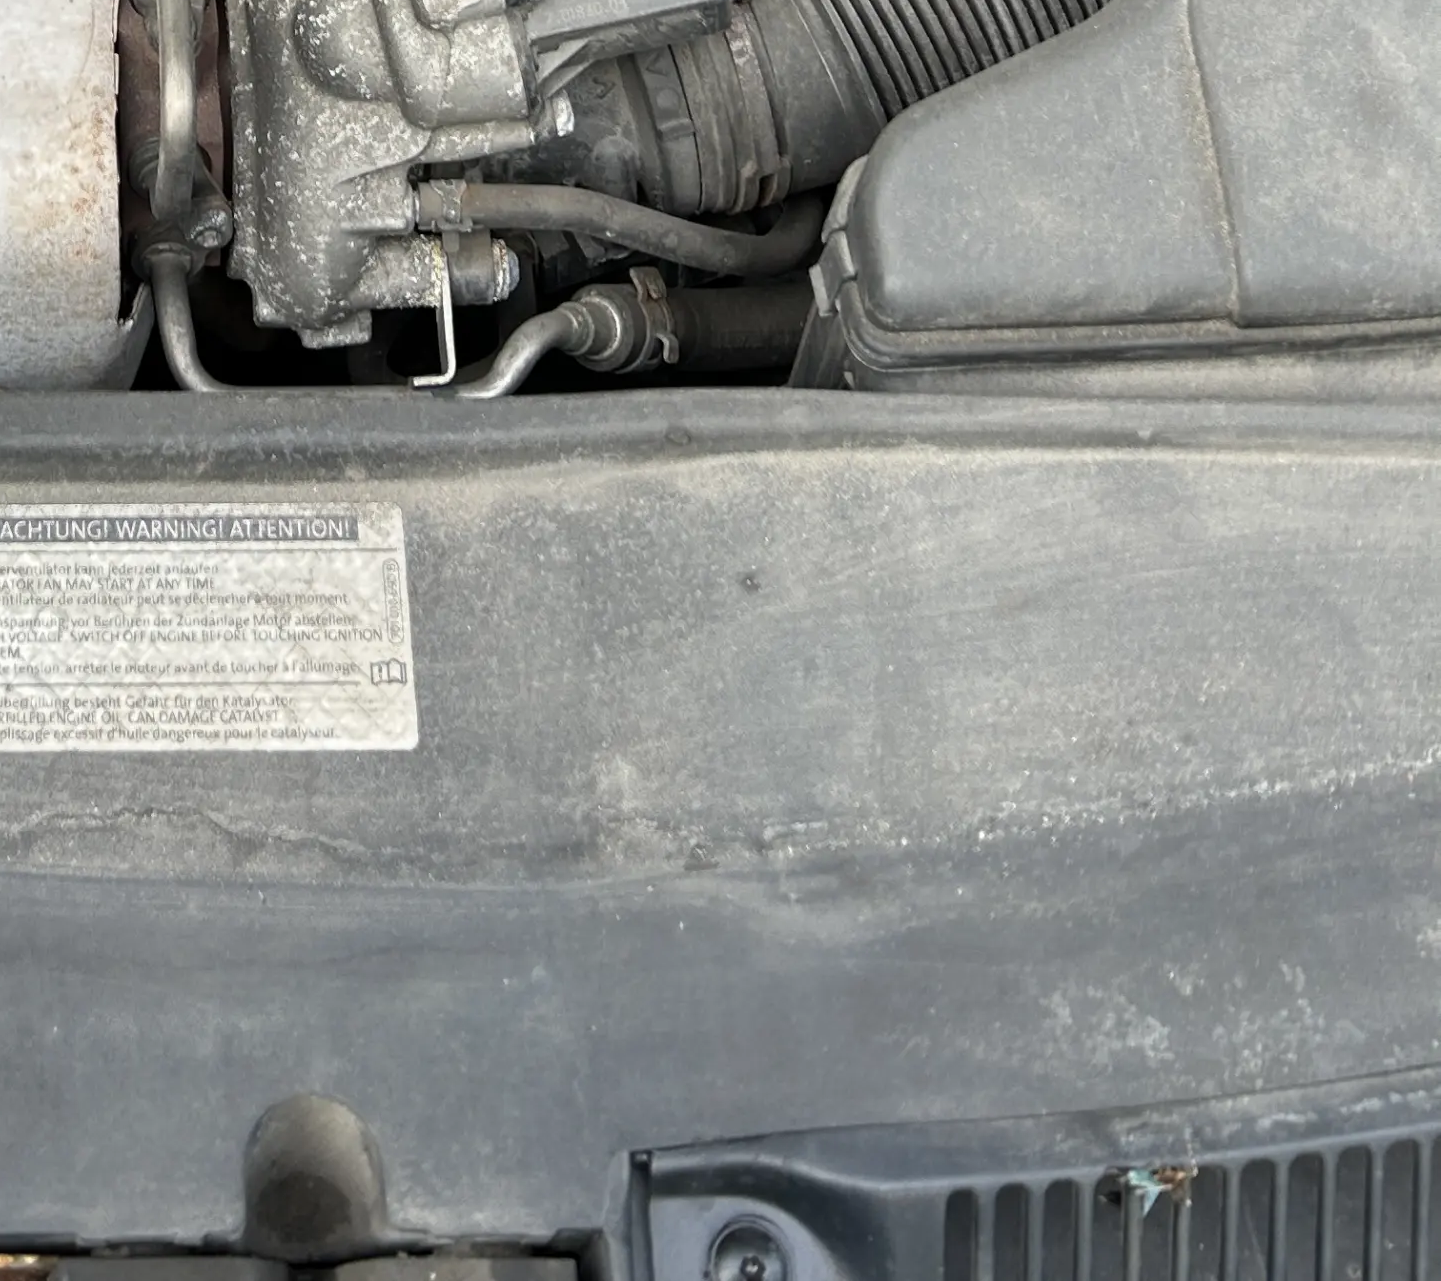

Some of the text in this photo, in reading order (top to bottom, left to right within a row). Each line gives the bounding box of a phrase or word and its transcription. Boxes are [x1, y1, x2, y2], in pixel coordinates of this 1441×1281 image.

[0, 518, 350, 540] ACHTUNG! WARNING! ATTENTION!
[74, 563, 104, 575] kann
[106, 564, 160, 578] jederzeit
[37, 578, 61, 590] FAN
[65, 578, 94, 590] MAY
[98, 577, 134, 590] START
[138, 577, 153, 589] AT
[156, 577, 181, 589] ANY
[59, 593, 74, 605] de
[77, 593, 135, 605] radiateur
[137, 594, 166, 607] peut
[169, 596, 182, 605] se
[184, 592, 251, 605] déclencher
[265, 591, 291, 605] tout
[71, 618, 89, 627] vor
[94, 615, 150, 627] Berühren
[153, 616, 172, 627] der
[253, 614, 291, 626] Motor
[70, 631, 120, 642] SWITCH
[123, 630, 145, 642] OFF
[150, 630, 197, 642] ENGINE
[201, 630, 247, 642] BEFORE
[252, 629, 321, 642] TOUCHING
[324, 627, 383, 642] IGNITION
[111, 662, 122, 673] le
[125, 664, 171, 674] moteur
[174, 662, 209, 673] avant
[212, 661, 228, 673] de
[231, 660, 278, 673] toucher
[74, 696, 121, 708] besteht
[125, 694, 171, 708] Gefahr
[174, 694, 192, 708] für
[195, 694, 219, 708] den
[49, 712, 97, 725] ENGINE
[127, 711, 156, 724] CAN
[158, 710, 217, 724] DAMAGE
[53, 726, 103, 739] excessif
[106, 726, 149, 740] d'huile
[152, 727, 221, 743] dangereux
[224, 728, 253, 742] pour
[255, 726, 269, 739] le
